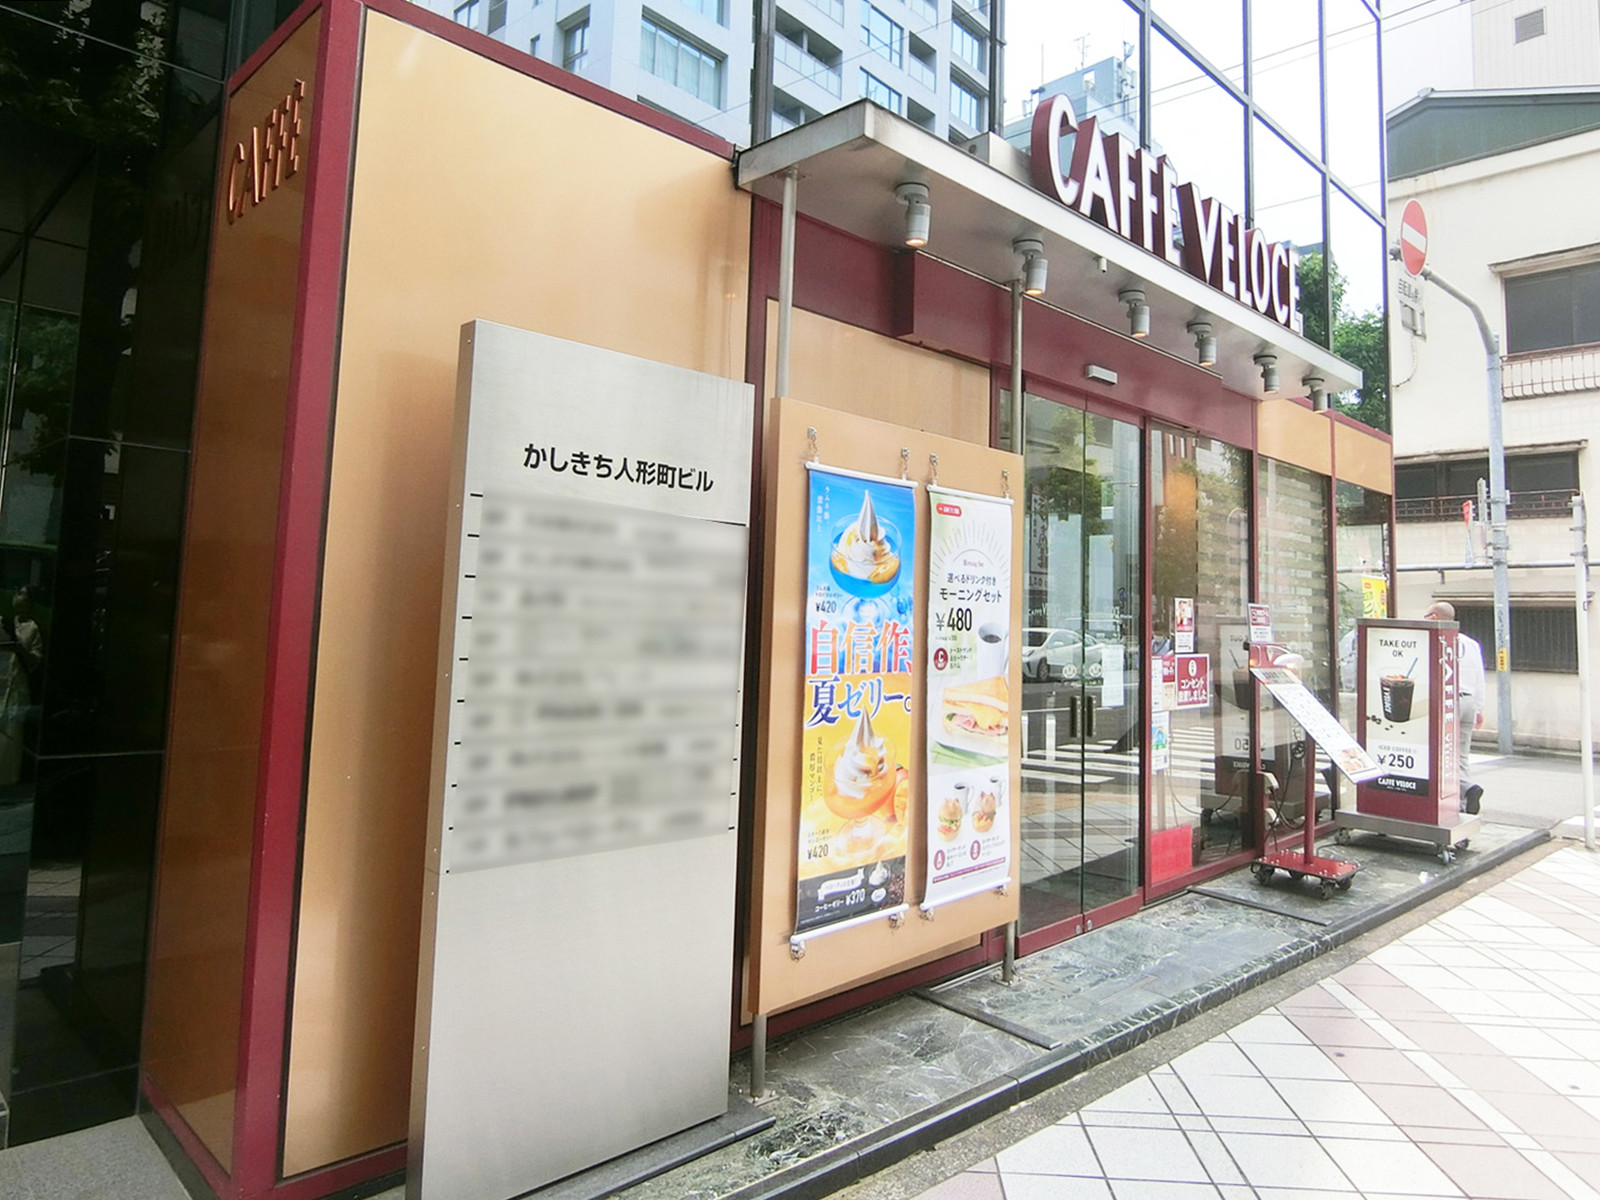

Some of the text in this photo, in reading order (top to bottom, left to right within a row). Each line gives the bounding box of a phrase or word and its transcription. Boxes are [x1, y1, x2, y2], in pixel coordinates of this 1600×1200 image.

[1184, 182, 1303, 337] VELOCE
[523, 443, 714, 492] かしきち人形町ビル
[939, 586, 1003, 604] モーニングセット
[815, 600, 837, 614] ¥420
[935, 607, 973, 632] ¥480
[1379, 639, 1417, 649] TAKE OUT
[1392, 650, 1404, 658] OK
[1180, 676, 1204, 690] コンセント
[1377, 753, 1415, 770] ¥250
[807, 843, 829, 860] ¥420
[845, 888, 866, 907] ¥370
